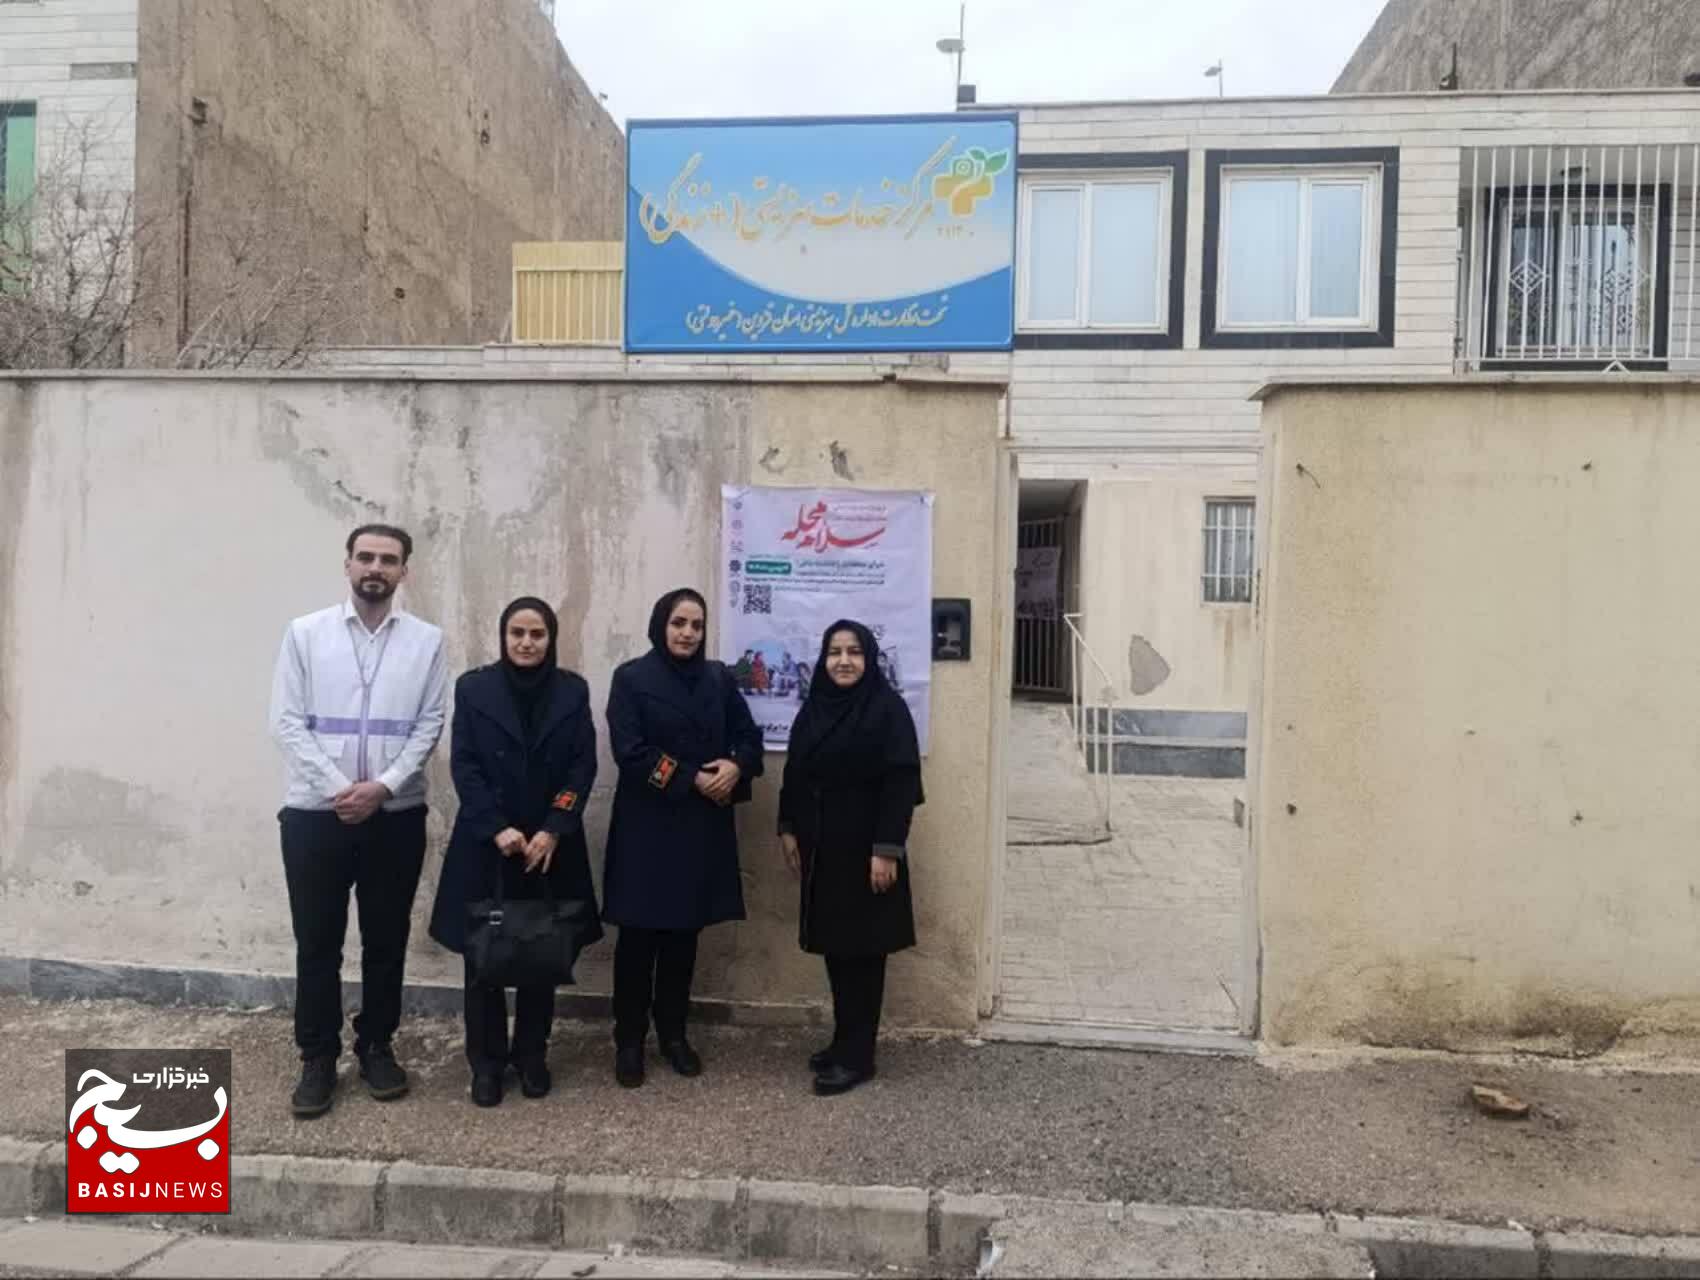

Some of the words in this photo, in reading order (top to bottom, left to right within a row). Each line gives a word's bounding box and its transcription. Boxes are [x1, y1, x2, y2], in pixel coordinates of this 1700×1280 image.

[810, 177, 897, 228] خدمات
[891, 135, 959, 240] مرکز
[741, 301, 774, 341] قزوین
[771, 303, 801, 334] استان
[917, 294, 949, 327] تحت
